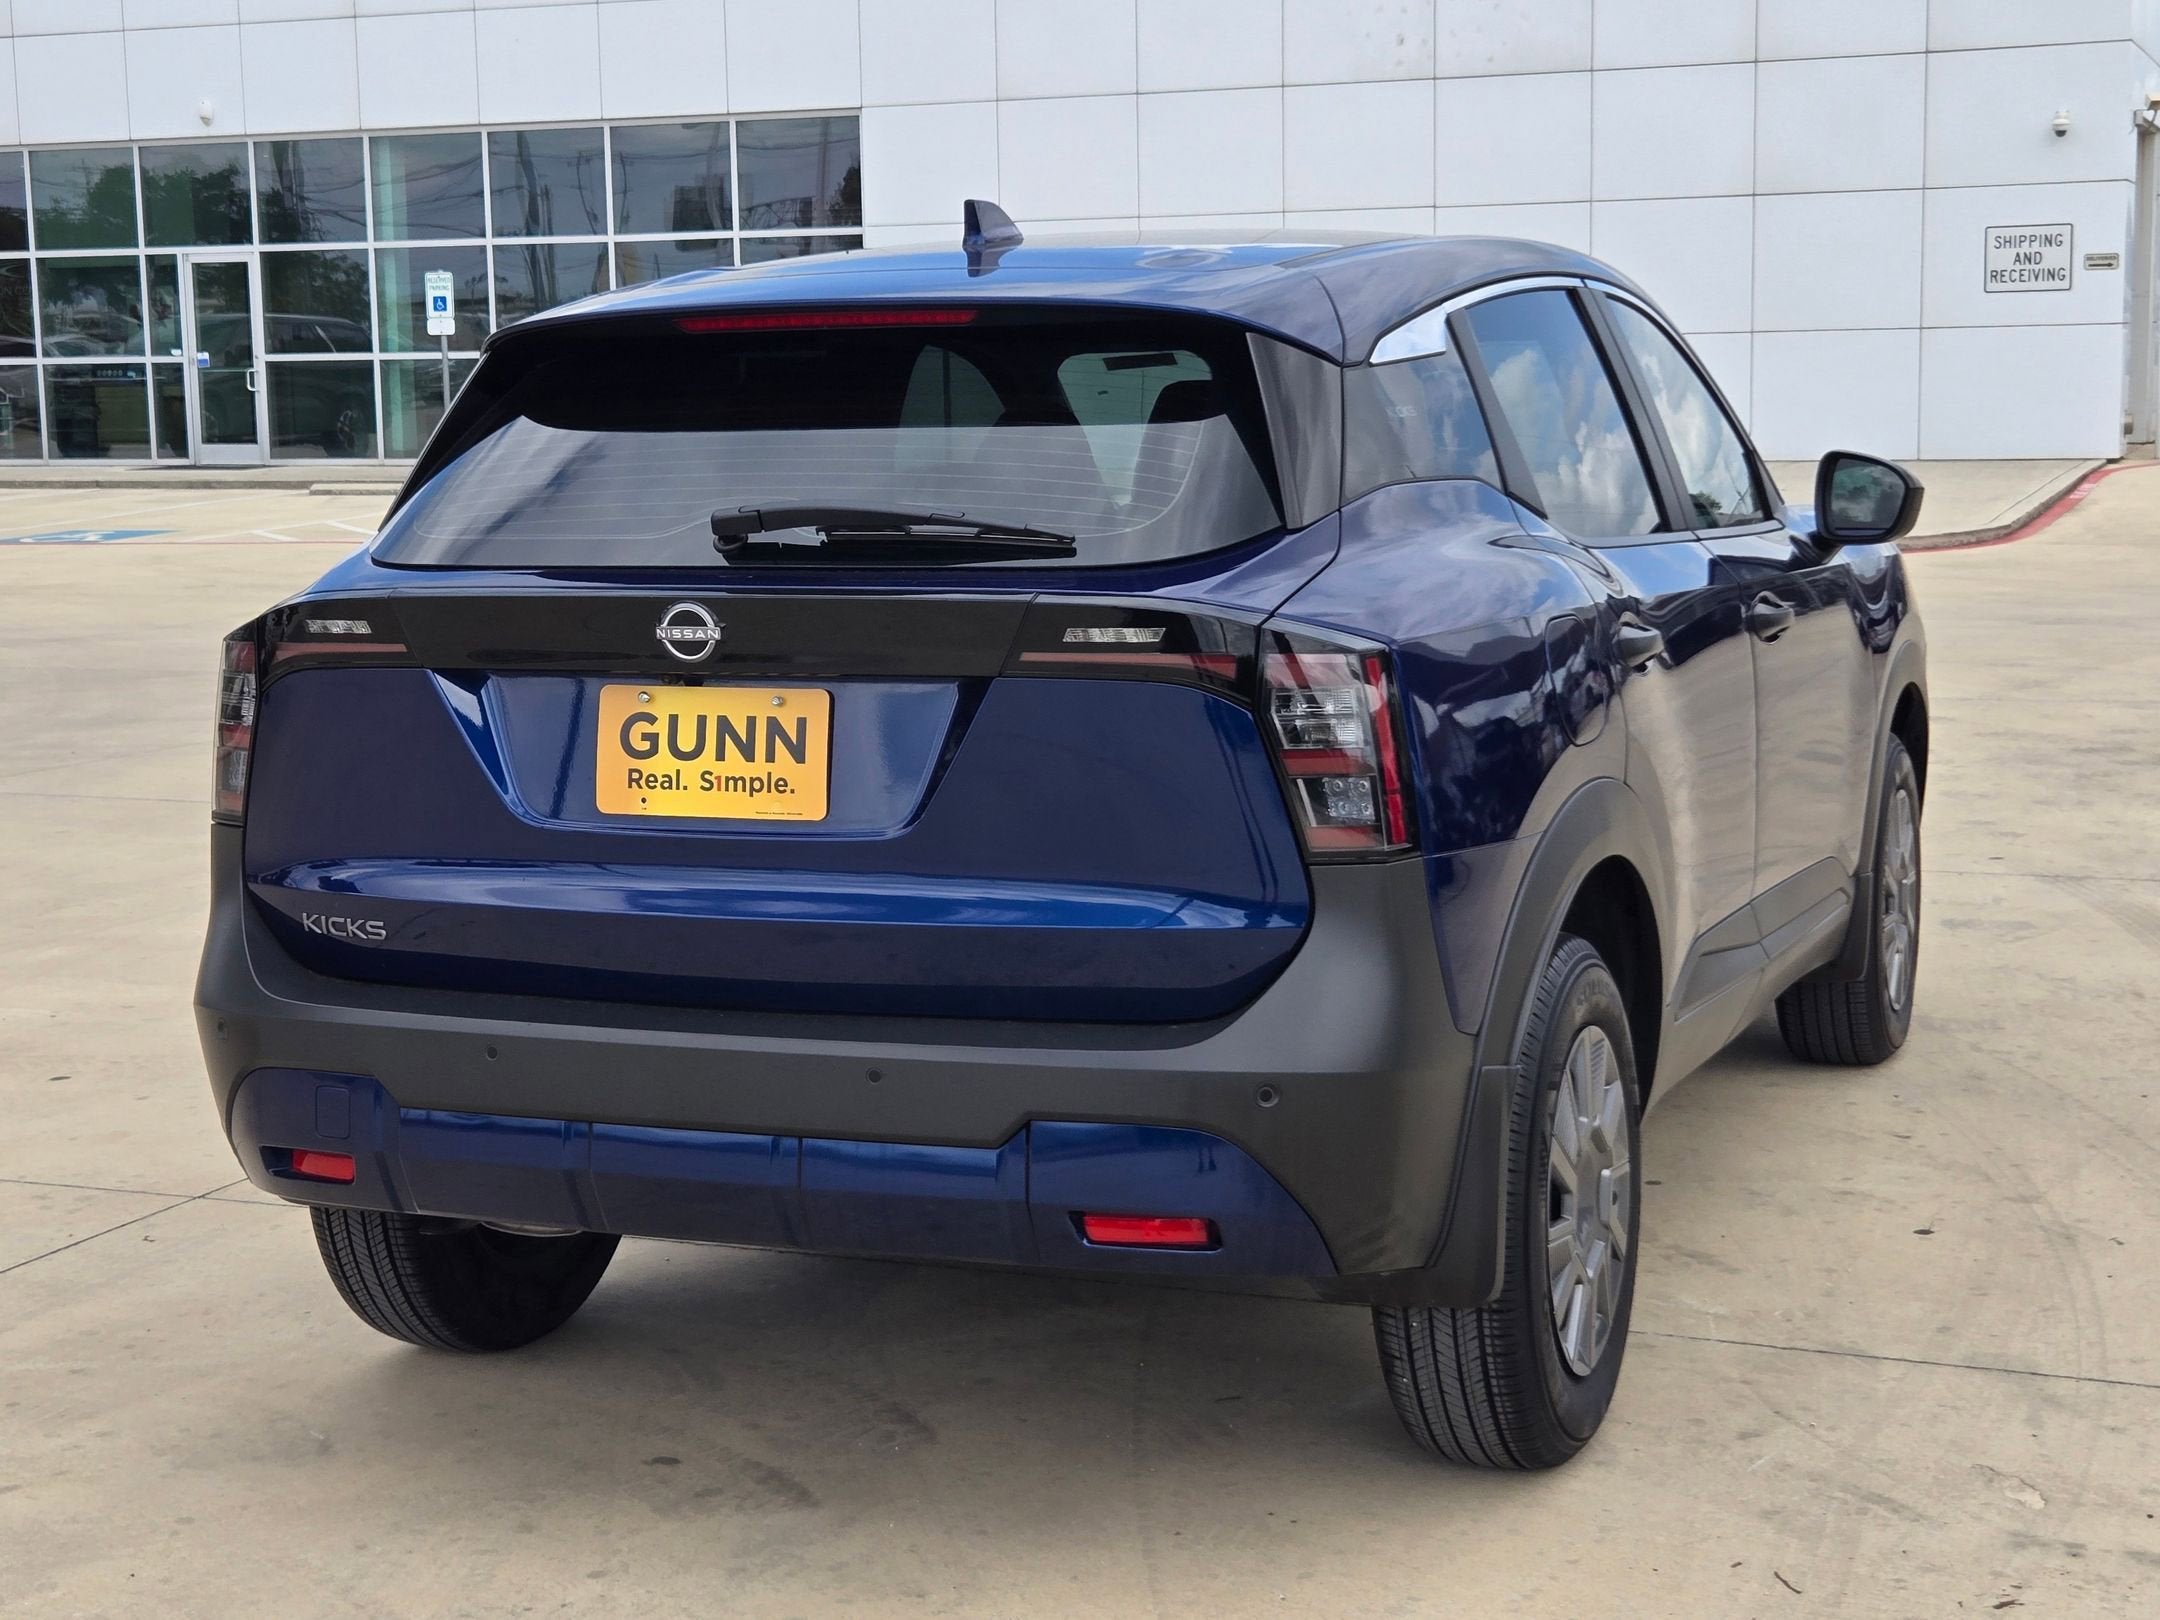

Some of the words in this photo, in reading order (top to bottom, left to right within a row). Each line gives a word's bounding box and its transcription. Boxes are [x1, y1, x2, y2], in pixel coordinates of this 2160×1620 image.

[1993, 233, 2063, 250] SHIPPING
[2012, 251, 2043, 266] AND
[1989, 267, 2066, 284] RECEIVING
[656, 628, 720, 640] NISSAN
[619, 711, 808, 765] GUNN
[627, 768, 688, 791] Real.
[302, 912, 387, 940] KICKS
